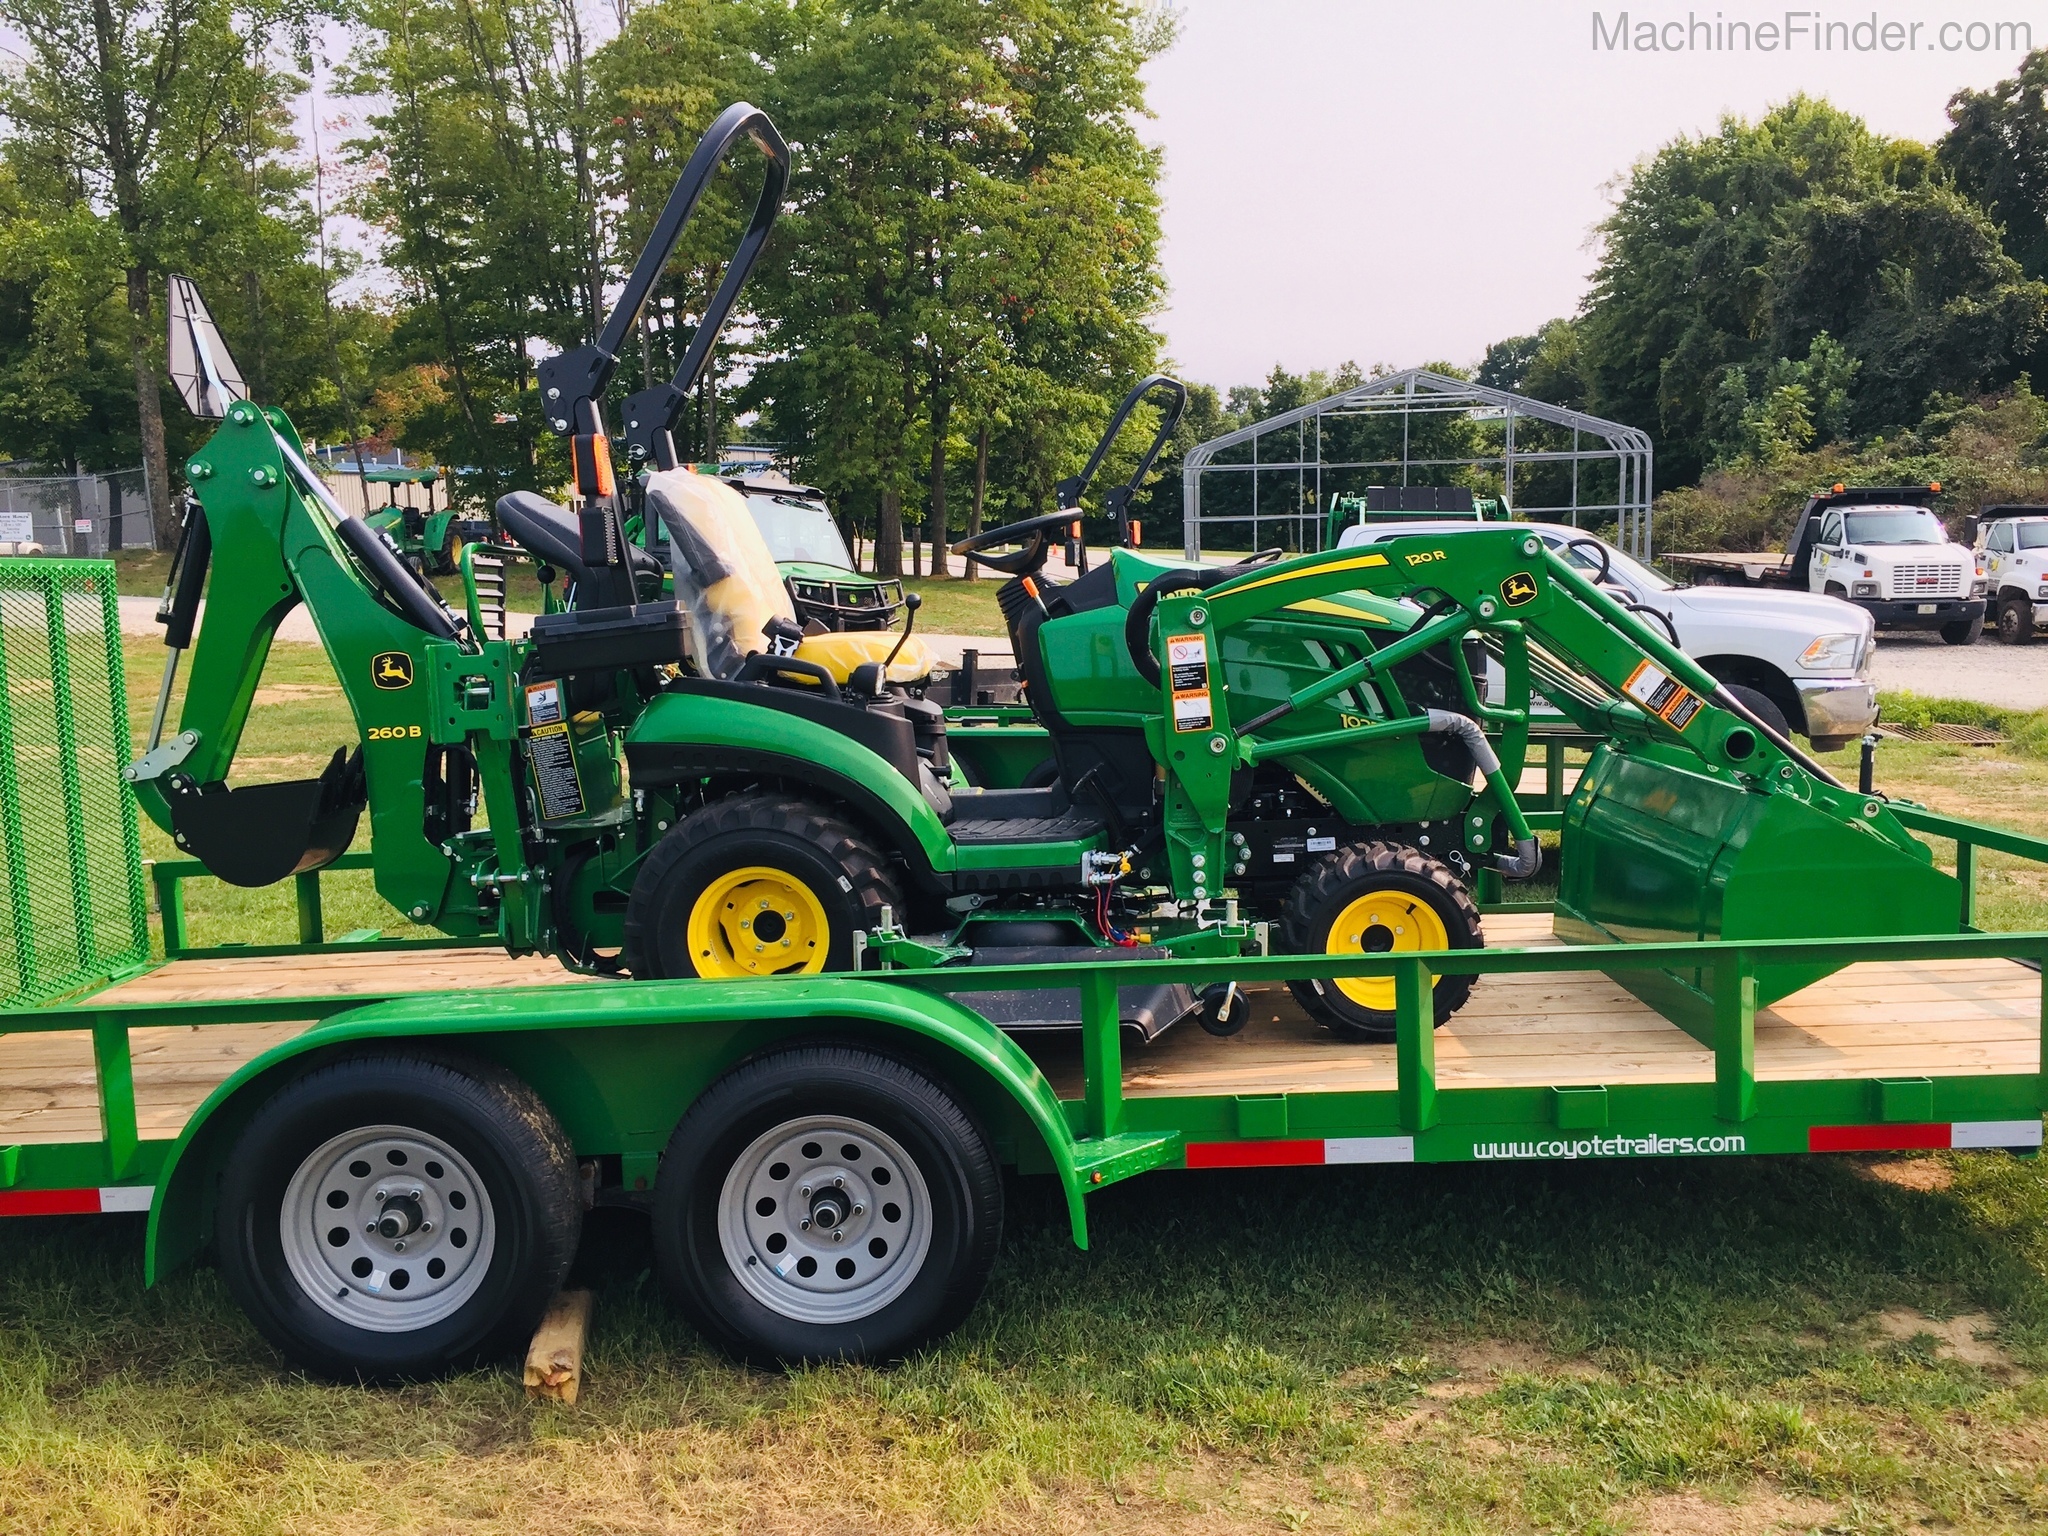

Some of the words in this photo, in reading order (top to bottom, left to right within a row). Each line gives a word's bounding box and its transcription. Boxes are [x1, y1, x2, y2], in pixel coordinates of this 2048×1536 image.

[1404, 553, 1433, 566] 120
[1432, 550, 1448, 561] R
[1174, 635, 1203, 643] WARNING
[1180, 691, 1208, 700] WARNING
[368, 726, 407, 740] 260
[408, 725, 422, 738] B
[536, 724, 563, 736] CAUTION
[1473, 1133, 1745, 1159] www.coyotetrailers.com
